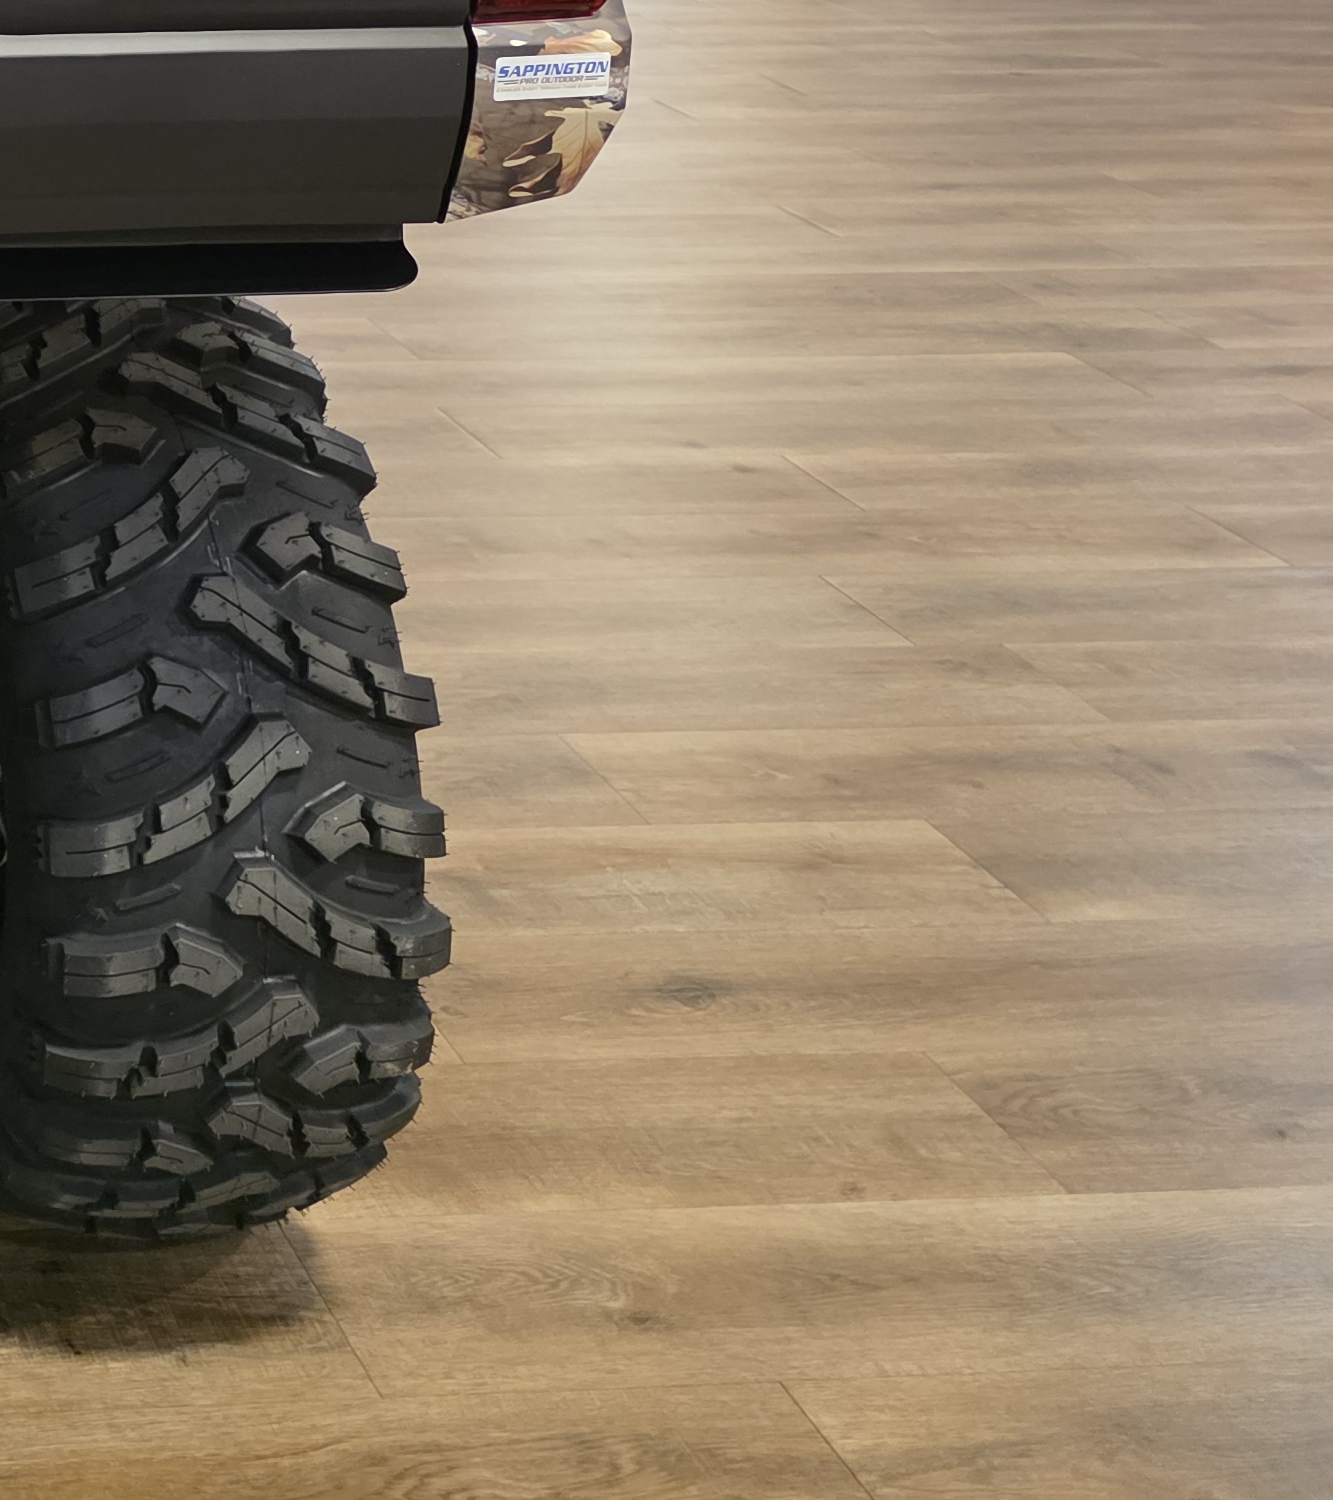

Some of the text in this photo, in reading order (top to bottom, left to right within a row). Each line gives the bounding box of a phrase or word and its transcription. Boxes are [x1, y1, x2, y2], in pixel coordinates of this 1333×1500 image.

[498, 61, 608, 78] SAPPINGTON
[519, 75, 585, 85] PRO OUTDOOR
